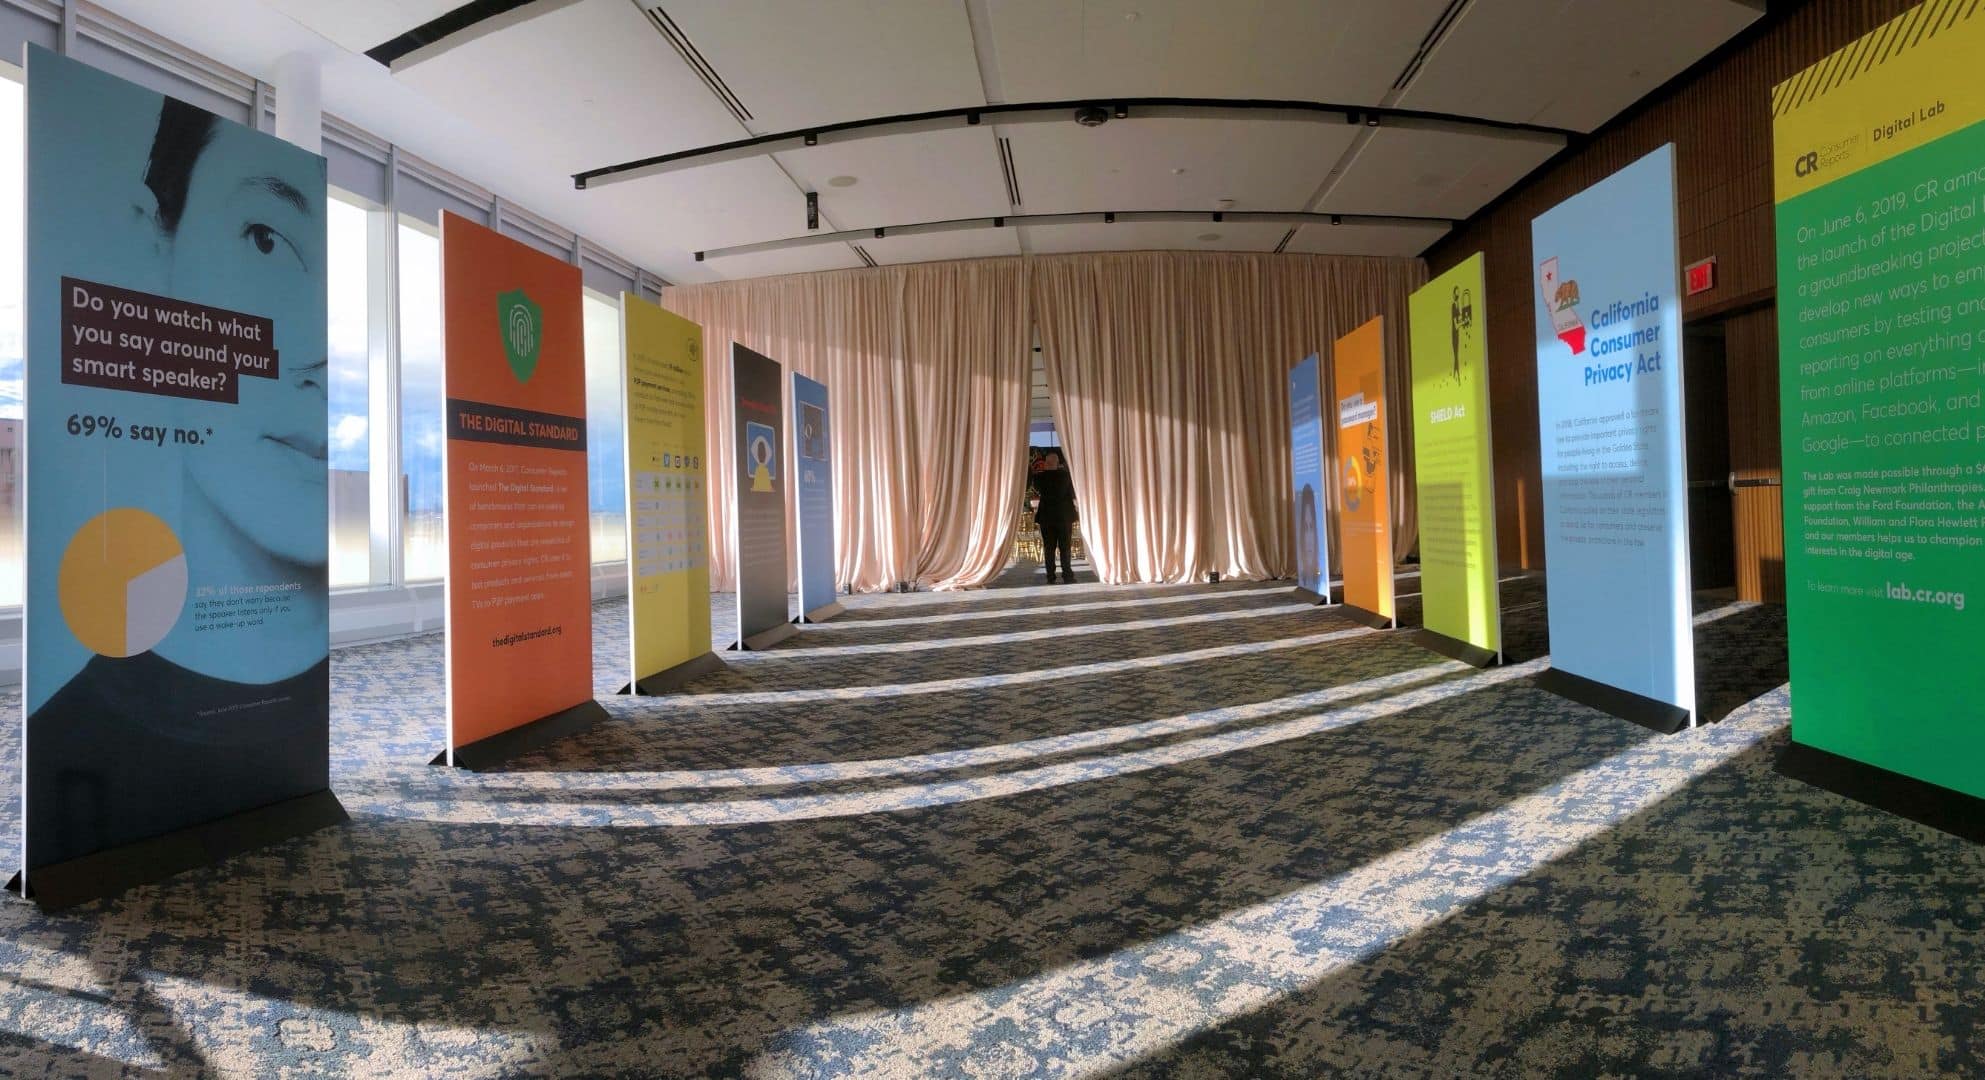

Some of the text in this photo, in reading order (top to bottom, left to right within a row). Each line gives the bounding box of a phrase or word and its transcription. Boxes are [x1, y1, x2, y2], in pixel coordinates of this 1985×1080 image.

[1873, 101, 1945, 142] Digital Lab
[1795, 151, 1818, 177] CR
[1797, 226, 1816, 244] On
[1821, 215, 1851, 236] June
[1855, 206, 1867, 225] 6,
[1872, 192, 1909, 218] 2019,
[1914, 180, 1938, 202] CR
[1797, 254, 1818, 271] the
[1822, 236, 1866, 263] launch
[1871, 226, 1887, 247] of
[1891, 222, 1915, 241] the
[1922, 197, 1976, 232] Digital
[1798, 284, 1807, 297] a
[1810, 250, 1923, 296] groundbreaking
[73, 286, 261, 342] Do you watch what
[1591, 292, 1659, 330] California
[1799, 299, 1850, 323] develop
[1854, 291, 1884, 310] new
[1888, 279, 1928, 304] ways
[1933, 272, 1949, 290] to
[1591, 325, 1661, 357] Consumer
[1800, 323, 1870, 350] consumers
[1875, 317, 1893, 335] by
[1897, 304, 1952, 328] testing
[73, 325, 270, 373] you say around your
[1800, 352, 1859, 377] reporting
[1864, 349, 1882, 364] on
[1887, 331, 1971, 360] everything
[73, 357, 227, 391] smart speaker?
[1585, 351, 1661, 386] Privacy Act
[1801, 385, 1830, 401] from
[1834, 378, 1875, 396] online
[1802, 388, 1981, 428] Amazon, Facebook, and
[67, 413, 123, 439] 69%
[130, 423, 167, 447] say
[460, 413, 578, 441] THE DIGITAL STANDARD
[1884, 422, 1969, 446] connected
[1803, 471, 1817, 481] The
[1819, 470, 1833, 480] Lab
[1836, 471, 1852, 480] was
[1854, 468, 1879, 479] made
[1881, 466, 1919, 480] possible
[1922, 464, 1963, 478] through
[1966, 465, 1973, 474] a
[1803, 486, 1815, 498] gift
[1818, 486, 1836, 495] from
[1838, 485, 1861, 497] Craig
[1863, 483, 1906, 495] Newmark
[1804, 501, 1833, 512] support
[1835, 501, 1854, 510] from
[1856, 501, 1870, 510] the
[1873, 500, 1893, 510] Ford
[1895, 500, 1954, 511] Foundation,
[1957, 499, 1974, 510] the
[1804, 515, 1978, 528] Foundation, William and Flora Hewlett
[1805, 531, 1819, 540] and
[1836, 531, 1875, 542] members
[1877, 531, 1901, 544] helps
[1904, 535, 1915, 543] us
[1917, 534, 1927, 544] to
[1930, 532, 1982, 546] champion
[1839, 548, 1847, 556] in
[1849, 547, 1863, 557] the
[1865, 548, 1893, 561] digital
[1895, 552, 1915, 562] age.
[1841, 585, 1864, 595] more
[1886, 581, 1965, 610] lab.cr.org
[491, 625, 562, 647] thedigitalstandard.org
